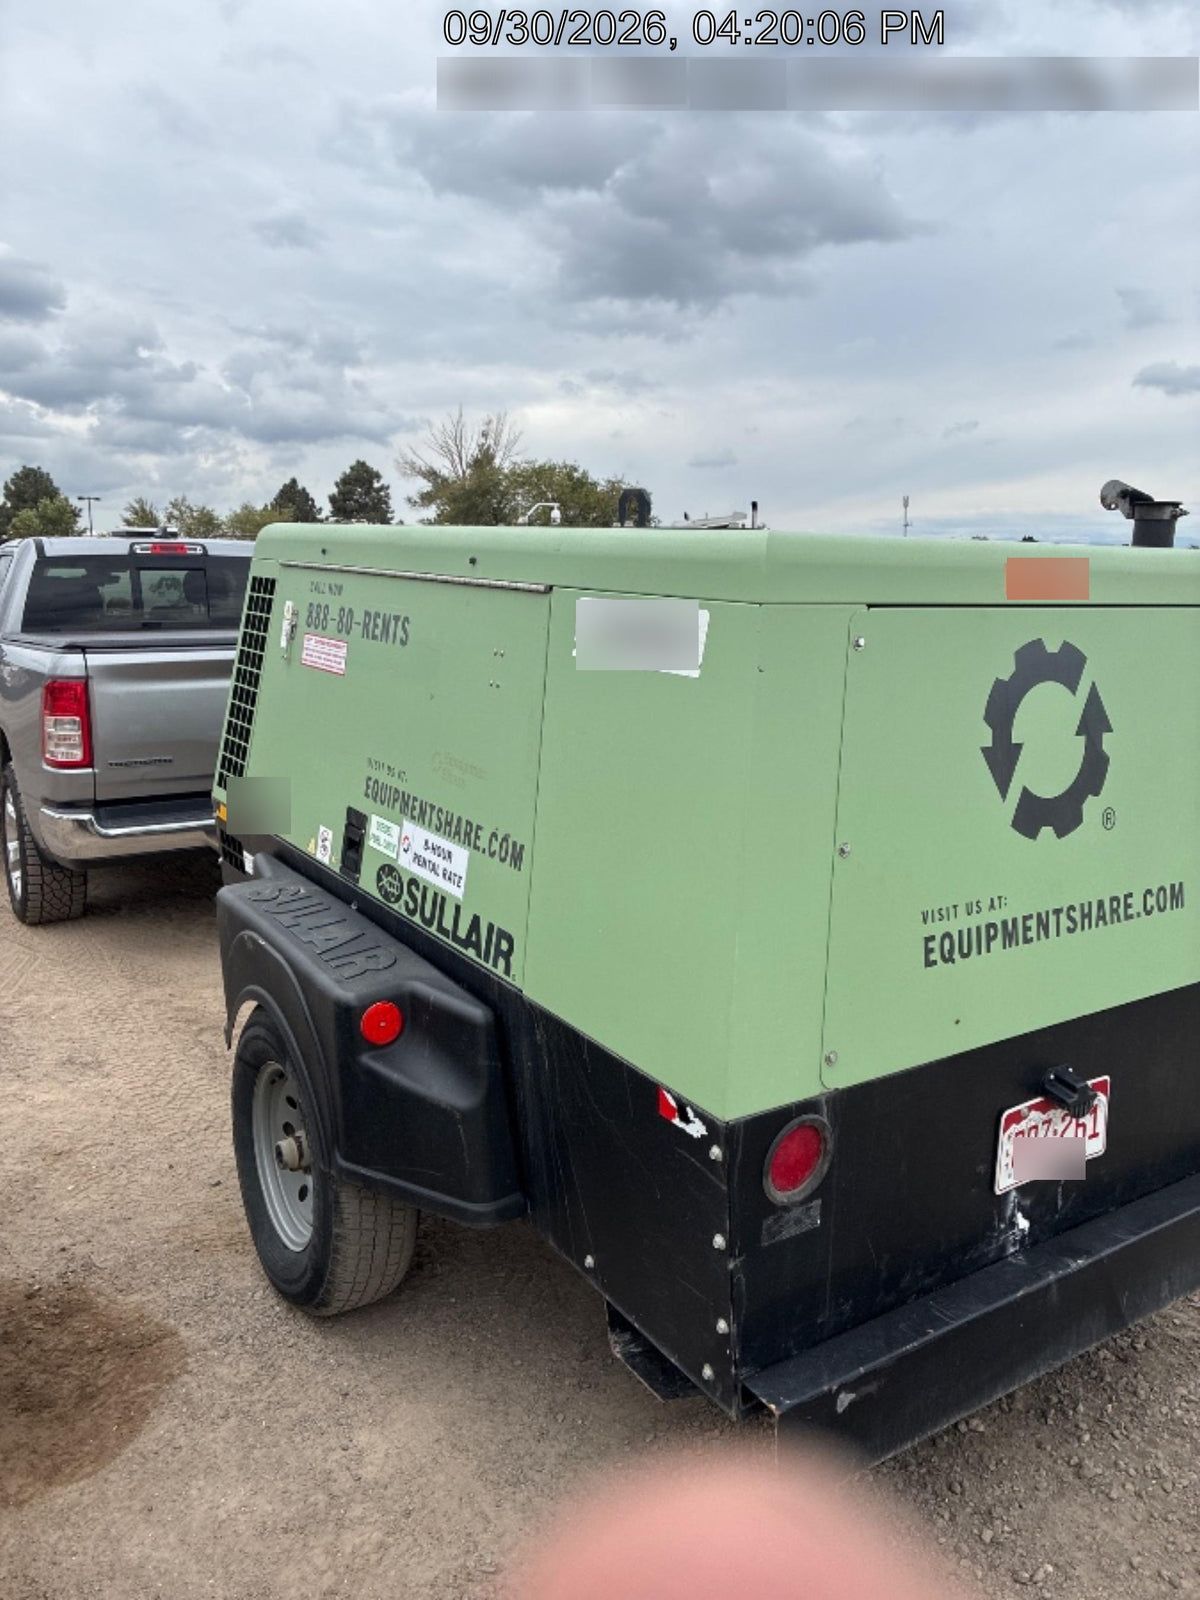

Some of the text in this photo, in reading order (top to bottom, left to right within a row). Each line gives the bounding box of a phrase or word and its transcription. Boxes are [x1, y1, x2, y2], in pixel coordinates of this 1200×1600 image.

[305, 602, 410, 647] 888-80-RENTS
[364, 776, 525, 872] EQUIPMENTSHARE.COM
[412, 851, 463, 888] RENTAL RATE
[404, 877, 514, 978] SULLAIR
[921, 895, 1008, 925] VISIT US AT:
[923, 881, 1185, 968] EQUIPMENTSHARE.COM
